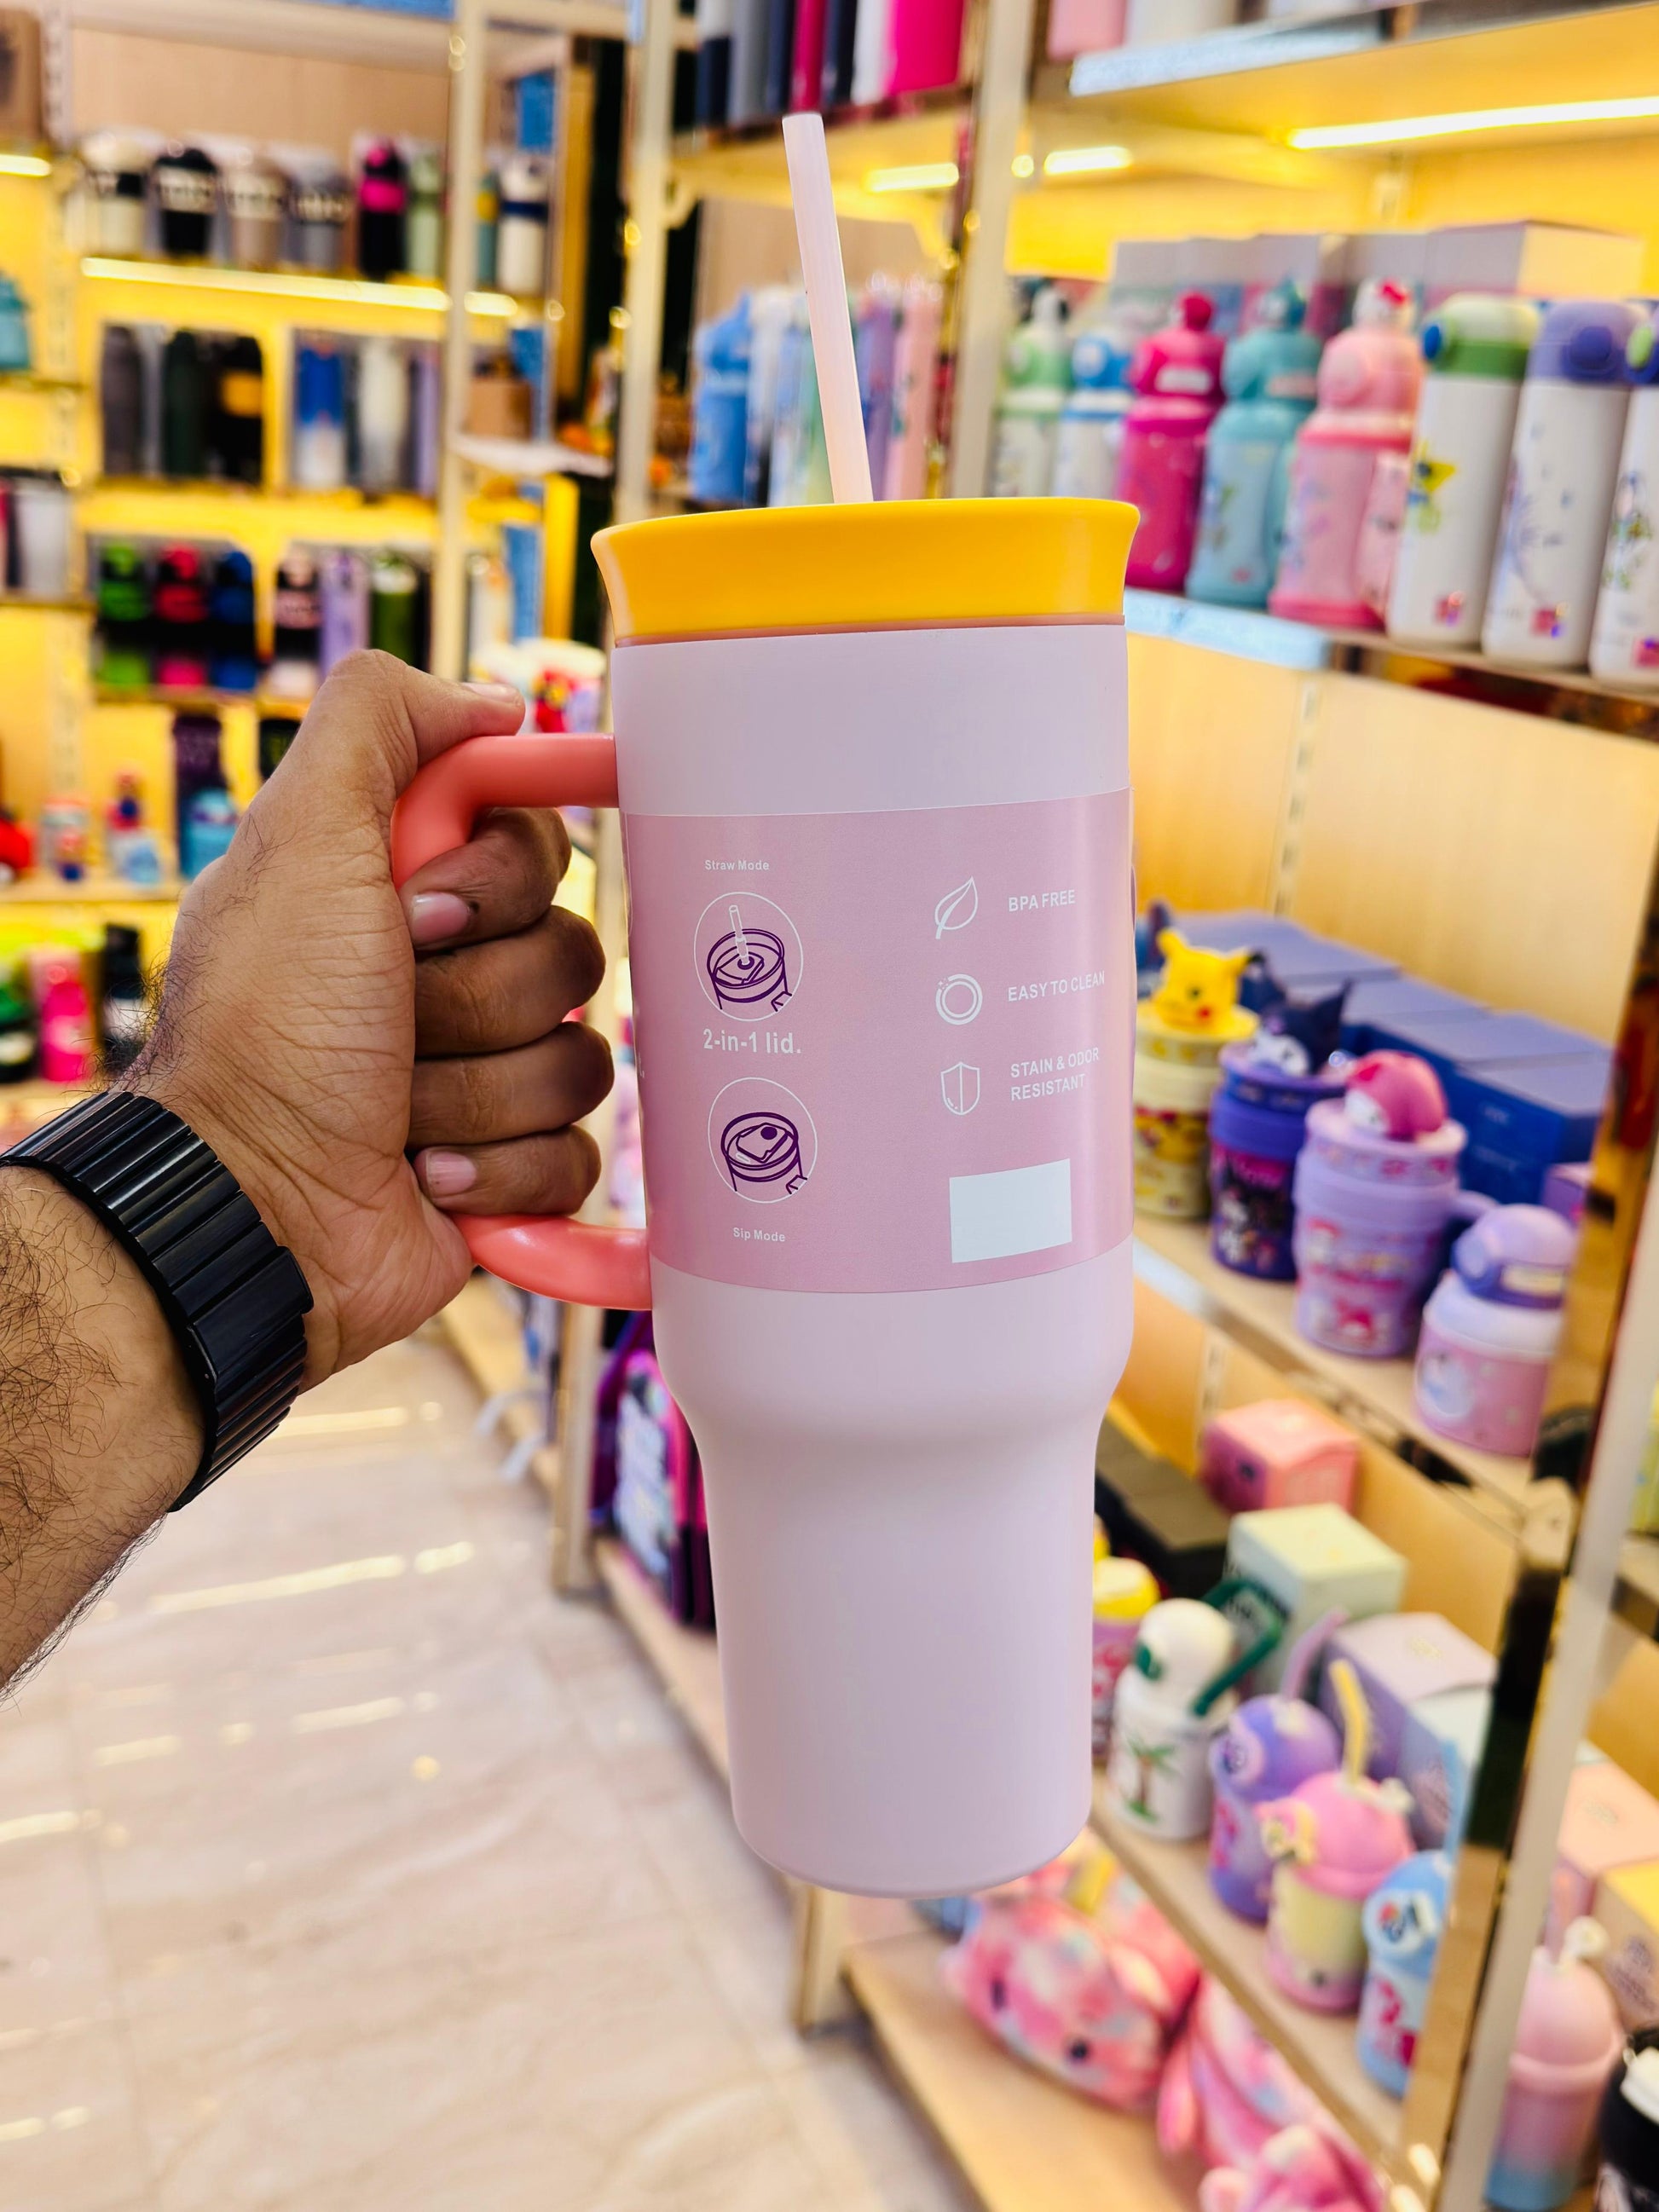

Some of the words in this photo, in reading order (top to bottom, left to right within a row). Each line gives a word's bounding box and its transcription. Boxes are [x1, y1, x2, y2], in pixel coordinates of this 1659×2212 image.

[704, 859, 735, 870] Straw
[737, 859, 770, 870] Mode
[1009, 894, 1038, 912] BPA
[1042, 889, 1076, 908] FREE
[1008, 982, 1048, 1002] EASY
[1050, 979, 1067, 996] TO
[1071, 970, 1105, 992] CLEAN
[703, 1028, 757, 1053] 2-in-1
[766, 1031, 801, 1054] lid.
[1010, 1058, 1053, 1078] STAIN
[1056, 1055, 1065, 1071] &
[1068, 1047, 1099, 1067] ODOR
[1010, 1073, 1085, 1101] RESISTANT
[733, 1227, 751, 1241] Sip
[754, 1229, 786, 1242] Mode
